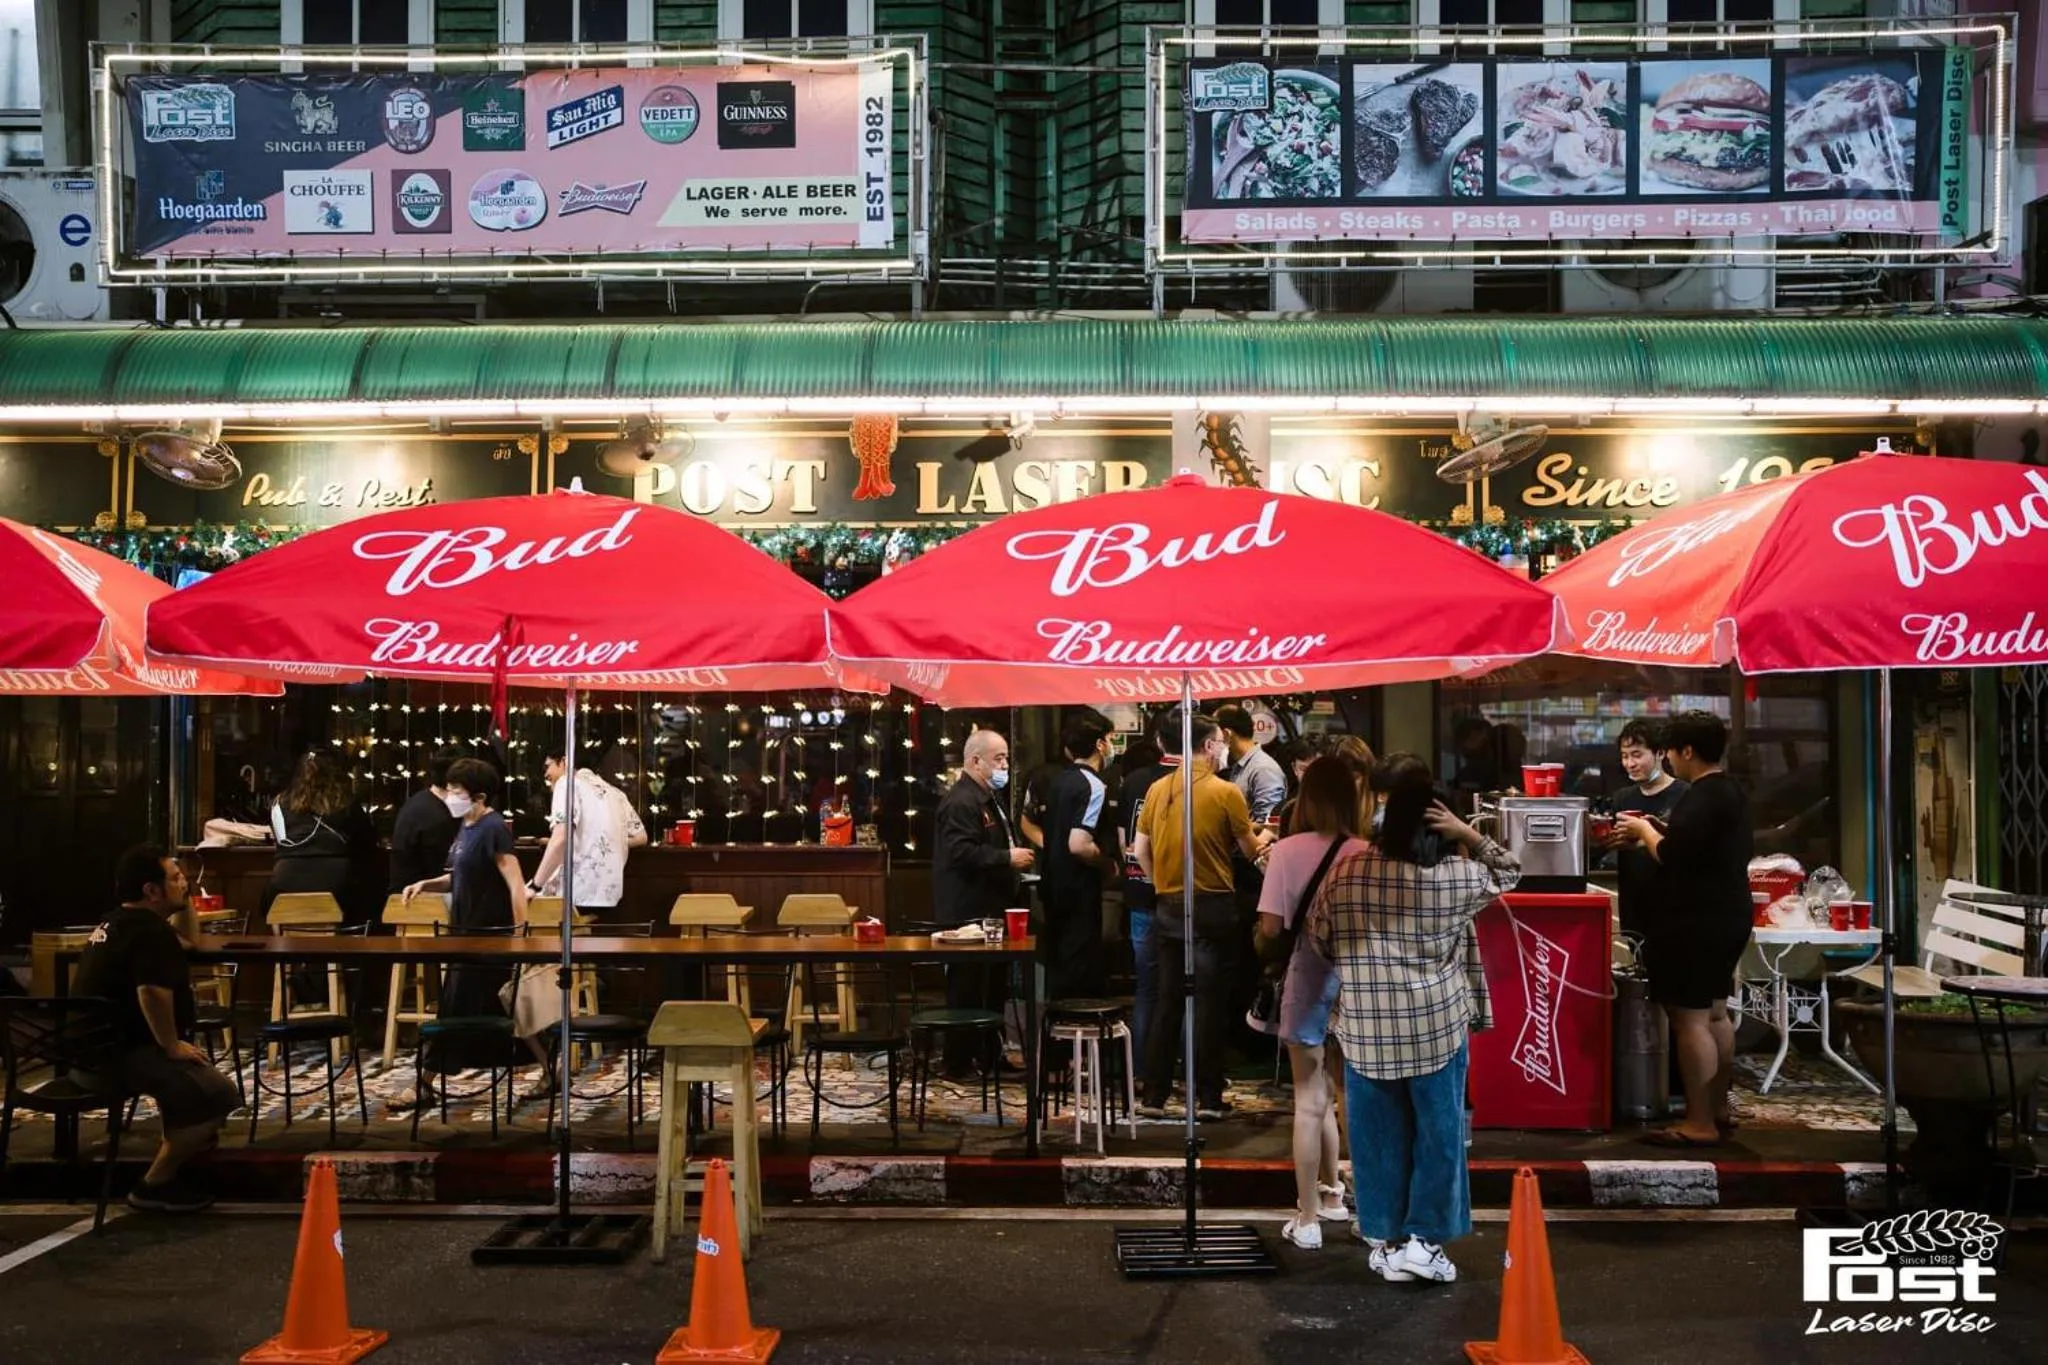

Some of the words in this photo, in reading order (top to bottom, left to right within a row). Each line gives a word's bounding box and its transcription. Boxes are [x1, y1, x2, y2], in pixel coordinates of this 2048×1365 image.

[1196, 72, 1265, 97] Post
[1947, 53, 1965, 101] Disc
[147, 92, 231, 125] Post
[386, 101, 431, 119] LEO
[552, 108, 583, 127] San
[584, 93, 617, 115] Mig
[643, 108, 693, 120] VEDETT
[723, 104, 787, 120] GUINNESS
[559, 114, 613, 141] LIGHT
[866, 97, 883, 157] 1982
[1944, 111, 1961, 171] Laser
[264, 141, 322, 153] SINGHA
[327, 140, 366, 153] BEER
[290, 185, 365, 196] CHOUFFE
[686, 186, 749, 200] LAGER
[762, 185, 798, 199] ALE
[806, 184, 857, 198] BEER
[867, 172, 884, 221] EST
[1943, 179, 1959, 226] Post
[159, 198, 265, 222] Hoegaarden
[705, 207, 730, 217] We
[741, 207, 788, 217] serve
[799, 206, 847, 217] more.
[1235, 213, 1317, 231] Salads
[1339, 211, 1424, 229] Steaks
[1452, 211, 1521, 228] Pasta
[1550, 210, 1646, 231] Burgers
[1674, 207, 1752, 227] Pizzas
[1780, 205, 1837, 223] Thai
[242, 473, 307, 507] Pub
[633, 460, 827, 514] POST
[916, 460, 1149, 514] LASER
[1522, 453, 1681, 507] Since
[352, 507, 641, 596] Bud
[1006, 499, 1286, 596] Bud
[364, 618, 640, 667] Budweiser
[1036, 617, 1326, 664] Budweiser
[1583, 609, 1711, 656] Budweiser
[1523, 935, 1552, 1082] Budweiser
